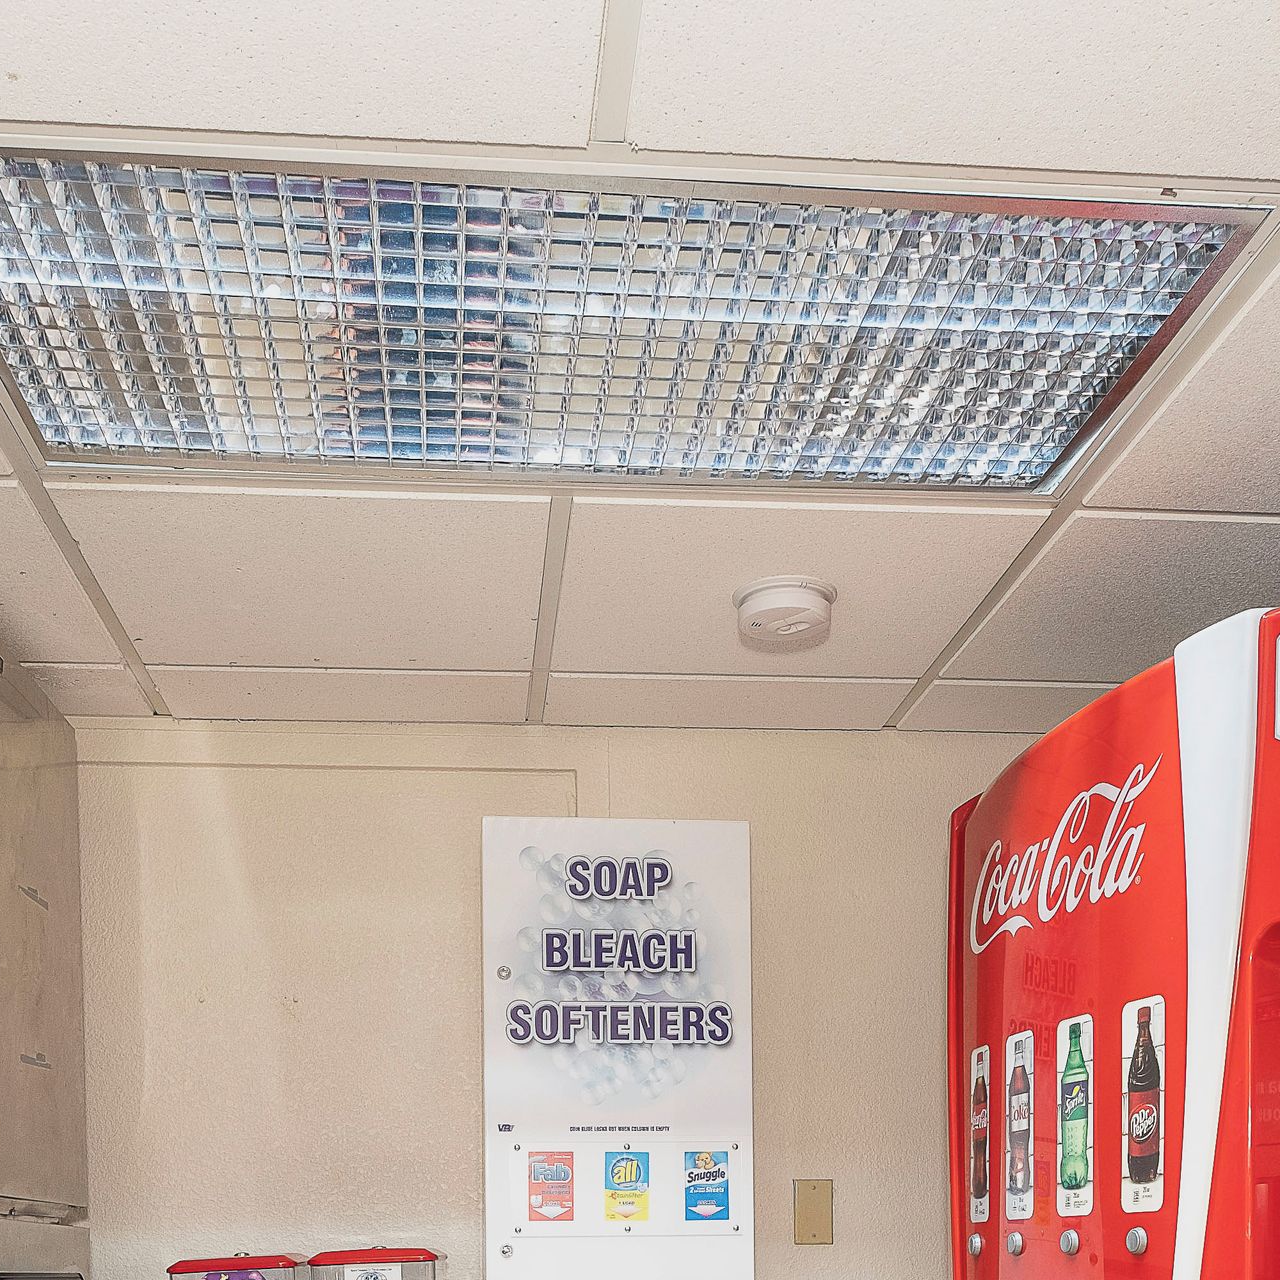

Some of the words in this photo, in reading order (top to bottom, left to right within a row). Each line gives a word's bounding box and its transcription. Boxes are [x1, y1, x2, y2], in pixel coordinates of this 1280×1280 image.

[970, 753, 1163, 955] Coca-Cola
[567, 858, 671, 898] SOAP
[543, 931, 695, 970] BLEACH
[508, 1003, 731, 1042] SOFTENERS
[1064, 1092, 1087, 1115] Sprite
[1138, 1108, 1150, 1123] Dr
[1130, 1110, 1157, 1138] Pepper
[532, 1163, 573, 1184] Fab
[612, 1160, 639, 1185] all
[687, 1168, 726, 1183] Snuggle
